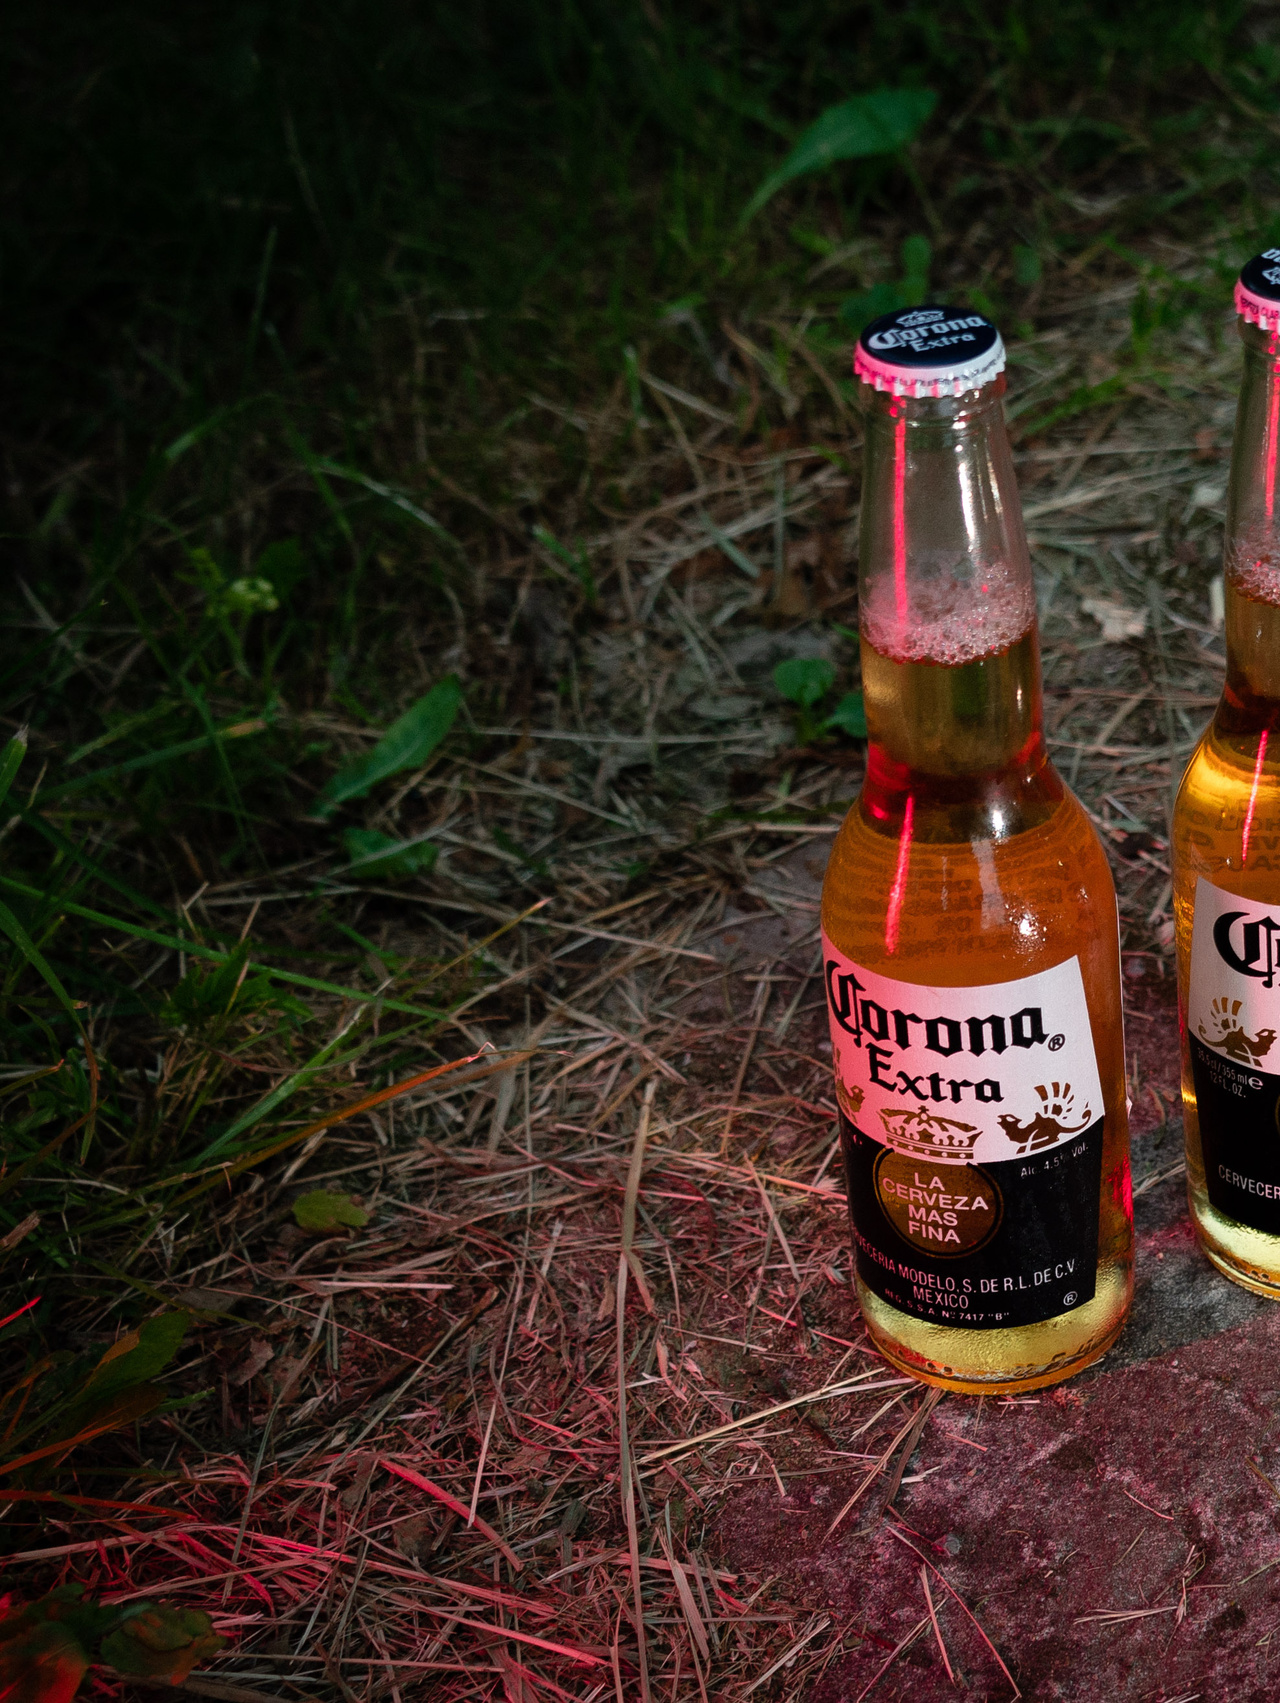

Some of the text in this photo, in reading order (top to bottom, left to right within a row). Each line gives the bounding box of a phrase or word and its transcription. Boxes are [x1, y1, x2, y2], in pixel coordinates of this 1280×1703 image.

[868, 316, 987, 350] Corona
[909, 333, 976, 352] Extra
[826, 960, 1050, 1058] Corona
[865, 1042, 1005, 1104] Extra
[882, 1177, 989, 1211] CERVEZA
[914, 1172, 945, 1191] LA
[908, 1204, 958, 1227] MAS
[908, 1220, 961, 1244] FINA
[962, 1278, 977, 1293] S.
[980, 1279, 999, 1293] DE
[1033, 1268, 1052, 1287] DE
[912, 1285, 969, 1310] MEXICO
[960, 1312, 984, 1321] 7417
